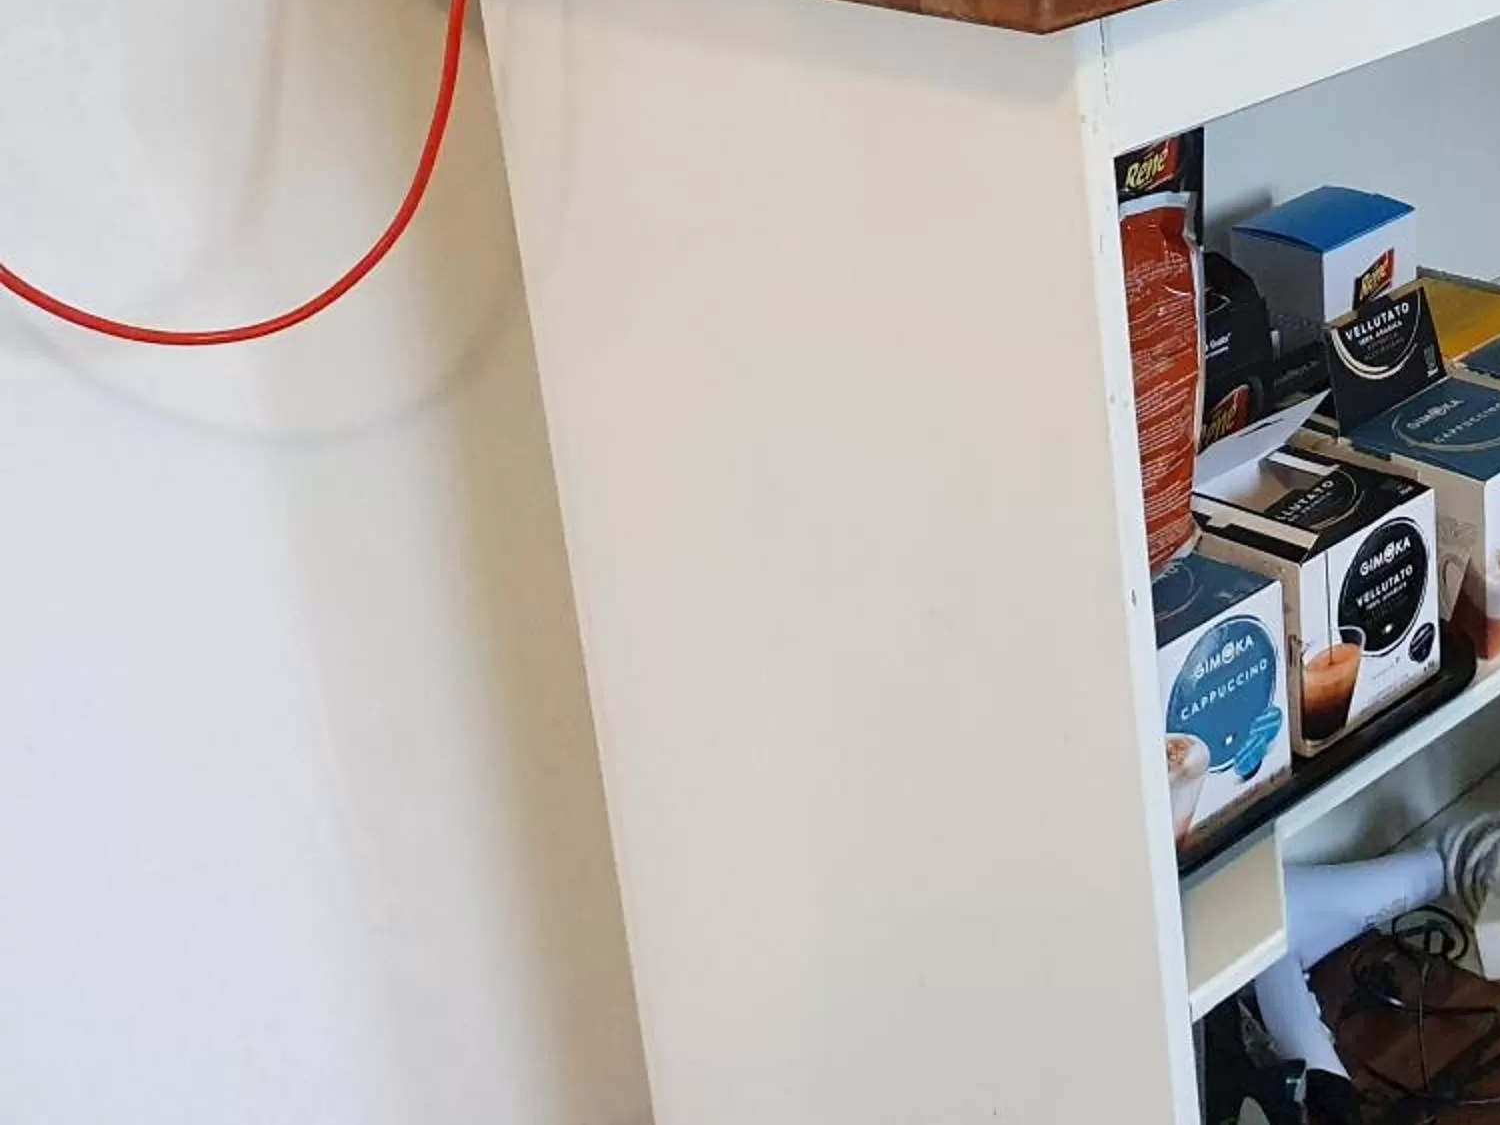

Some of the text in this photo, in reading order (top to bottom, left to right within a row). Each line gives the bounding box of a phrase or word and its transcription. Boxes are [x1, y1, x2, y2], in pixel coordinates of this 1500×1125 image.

[1125, 140, 1169, 188] René
[1345, 302, 1409, 342] VELLUTATO
[1274, 479, 1334, 521] LLUTATO
[1360, 536, 1411, 576] GIMOKA
[1356, 564, 1413, 607] VELLUTATO
[1193, 635, 1254, 680] GIMOKA
[1181, 658, 1268, 720] CAPPUCCINO
